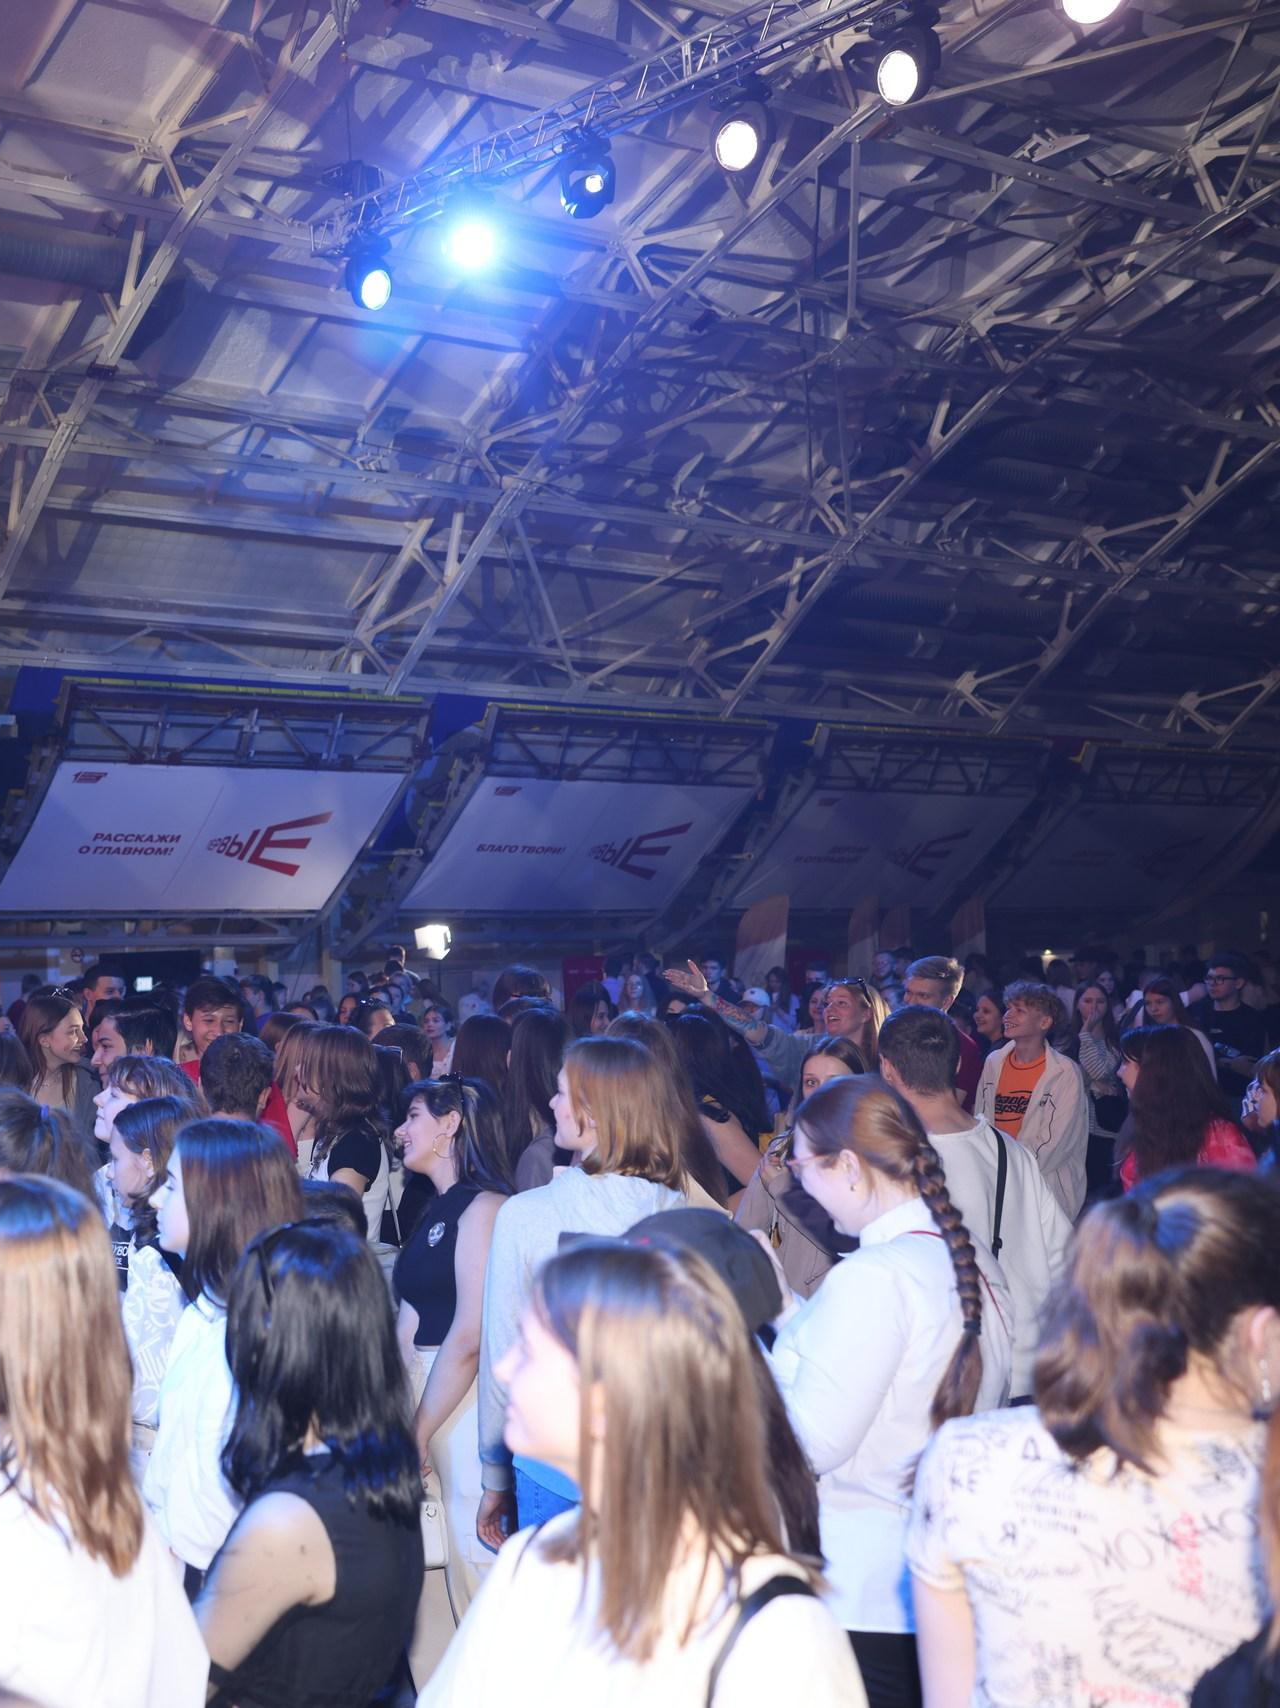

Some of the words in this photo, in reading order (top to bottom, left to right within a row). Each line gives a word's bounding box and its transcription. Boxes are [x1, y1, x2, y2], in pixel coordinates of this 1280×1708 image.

[92, 832, 182, 843] РАССКАЖИ
[78, 845, 90, 855] О
[92, 846, 175, 856] ГЛАВНОМ!
